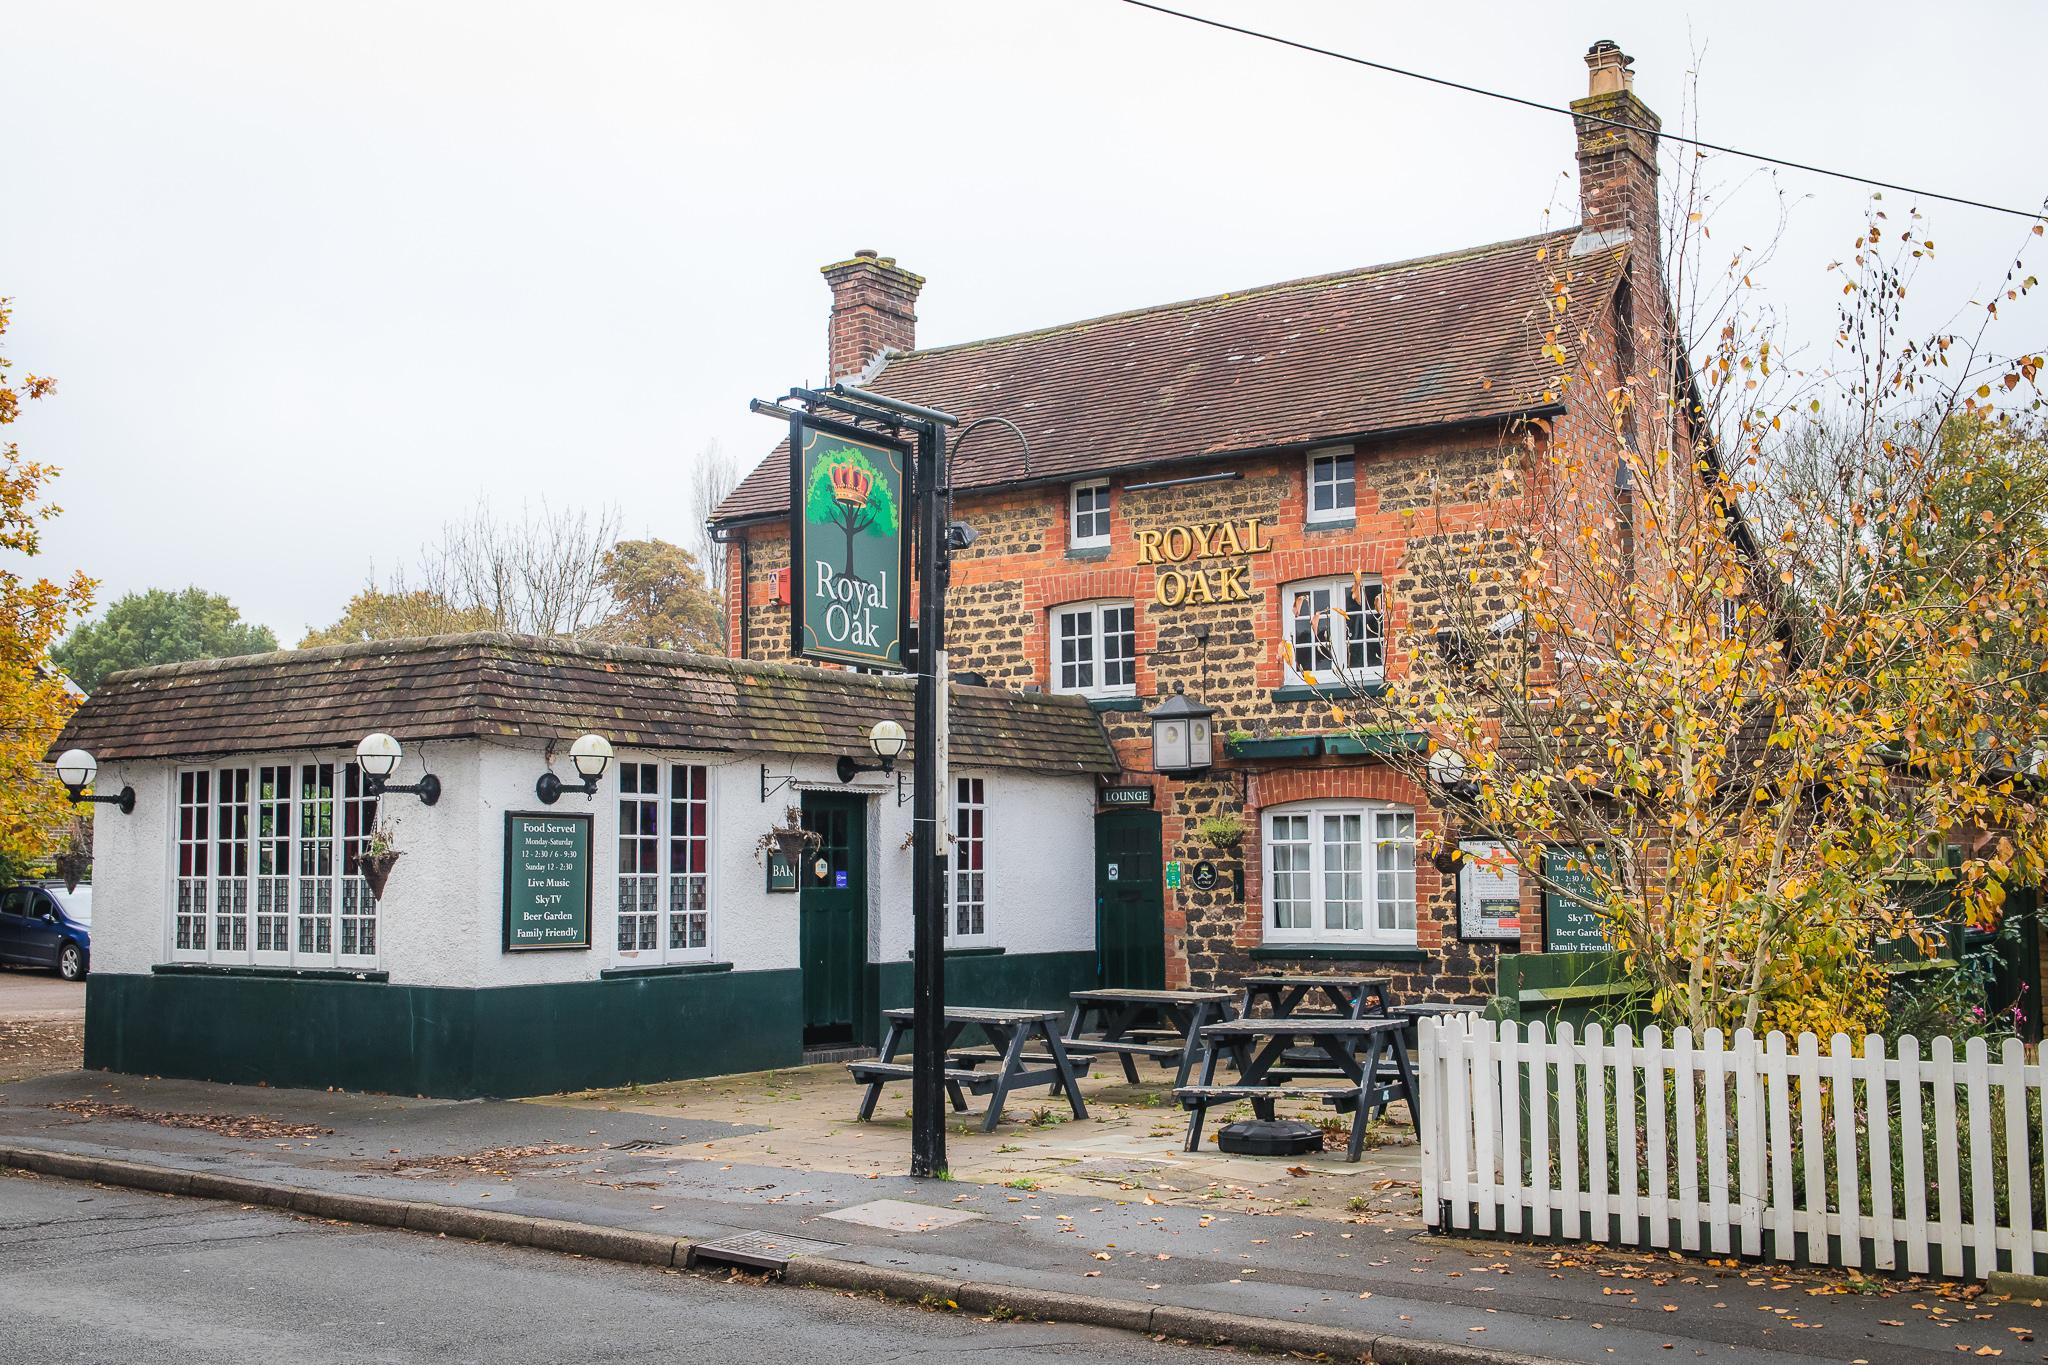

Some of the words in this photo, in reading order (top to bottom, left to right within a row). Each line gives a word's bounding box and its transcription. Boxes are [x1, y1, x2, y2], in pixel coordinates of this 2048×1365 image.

[1136, 518, 1272, 565] ROYAL
[816, 560, 888, 620] Royal
[1157, 565, 1250, 606] OAK
[826, 605, 879, 647] Oak
[1106, 791, 1148, 801] LOUNGE
[524, 823, 544, 832] Food
[547, 824, 575, 833] Served
[525, 838, 573, 848] Monday-Saturday
[526, 863, 545, 872] Sunday
[528, 878, 544, 887] Live
[546, 879, 570, 887] Music
[524, 912, 542, 920] Beer
[544, 912, 572, 920] Garden
[517, 929, 543, 940] Family
[545, 928, 578, 939] Friendly
[1550, 943, 1577, 953] Family
